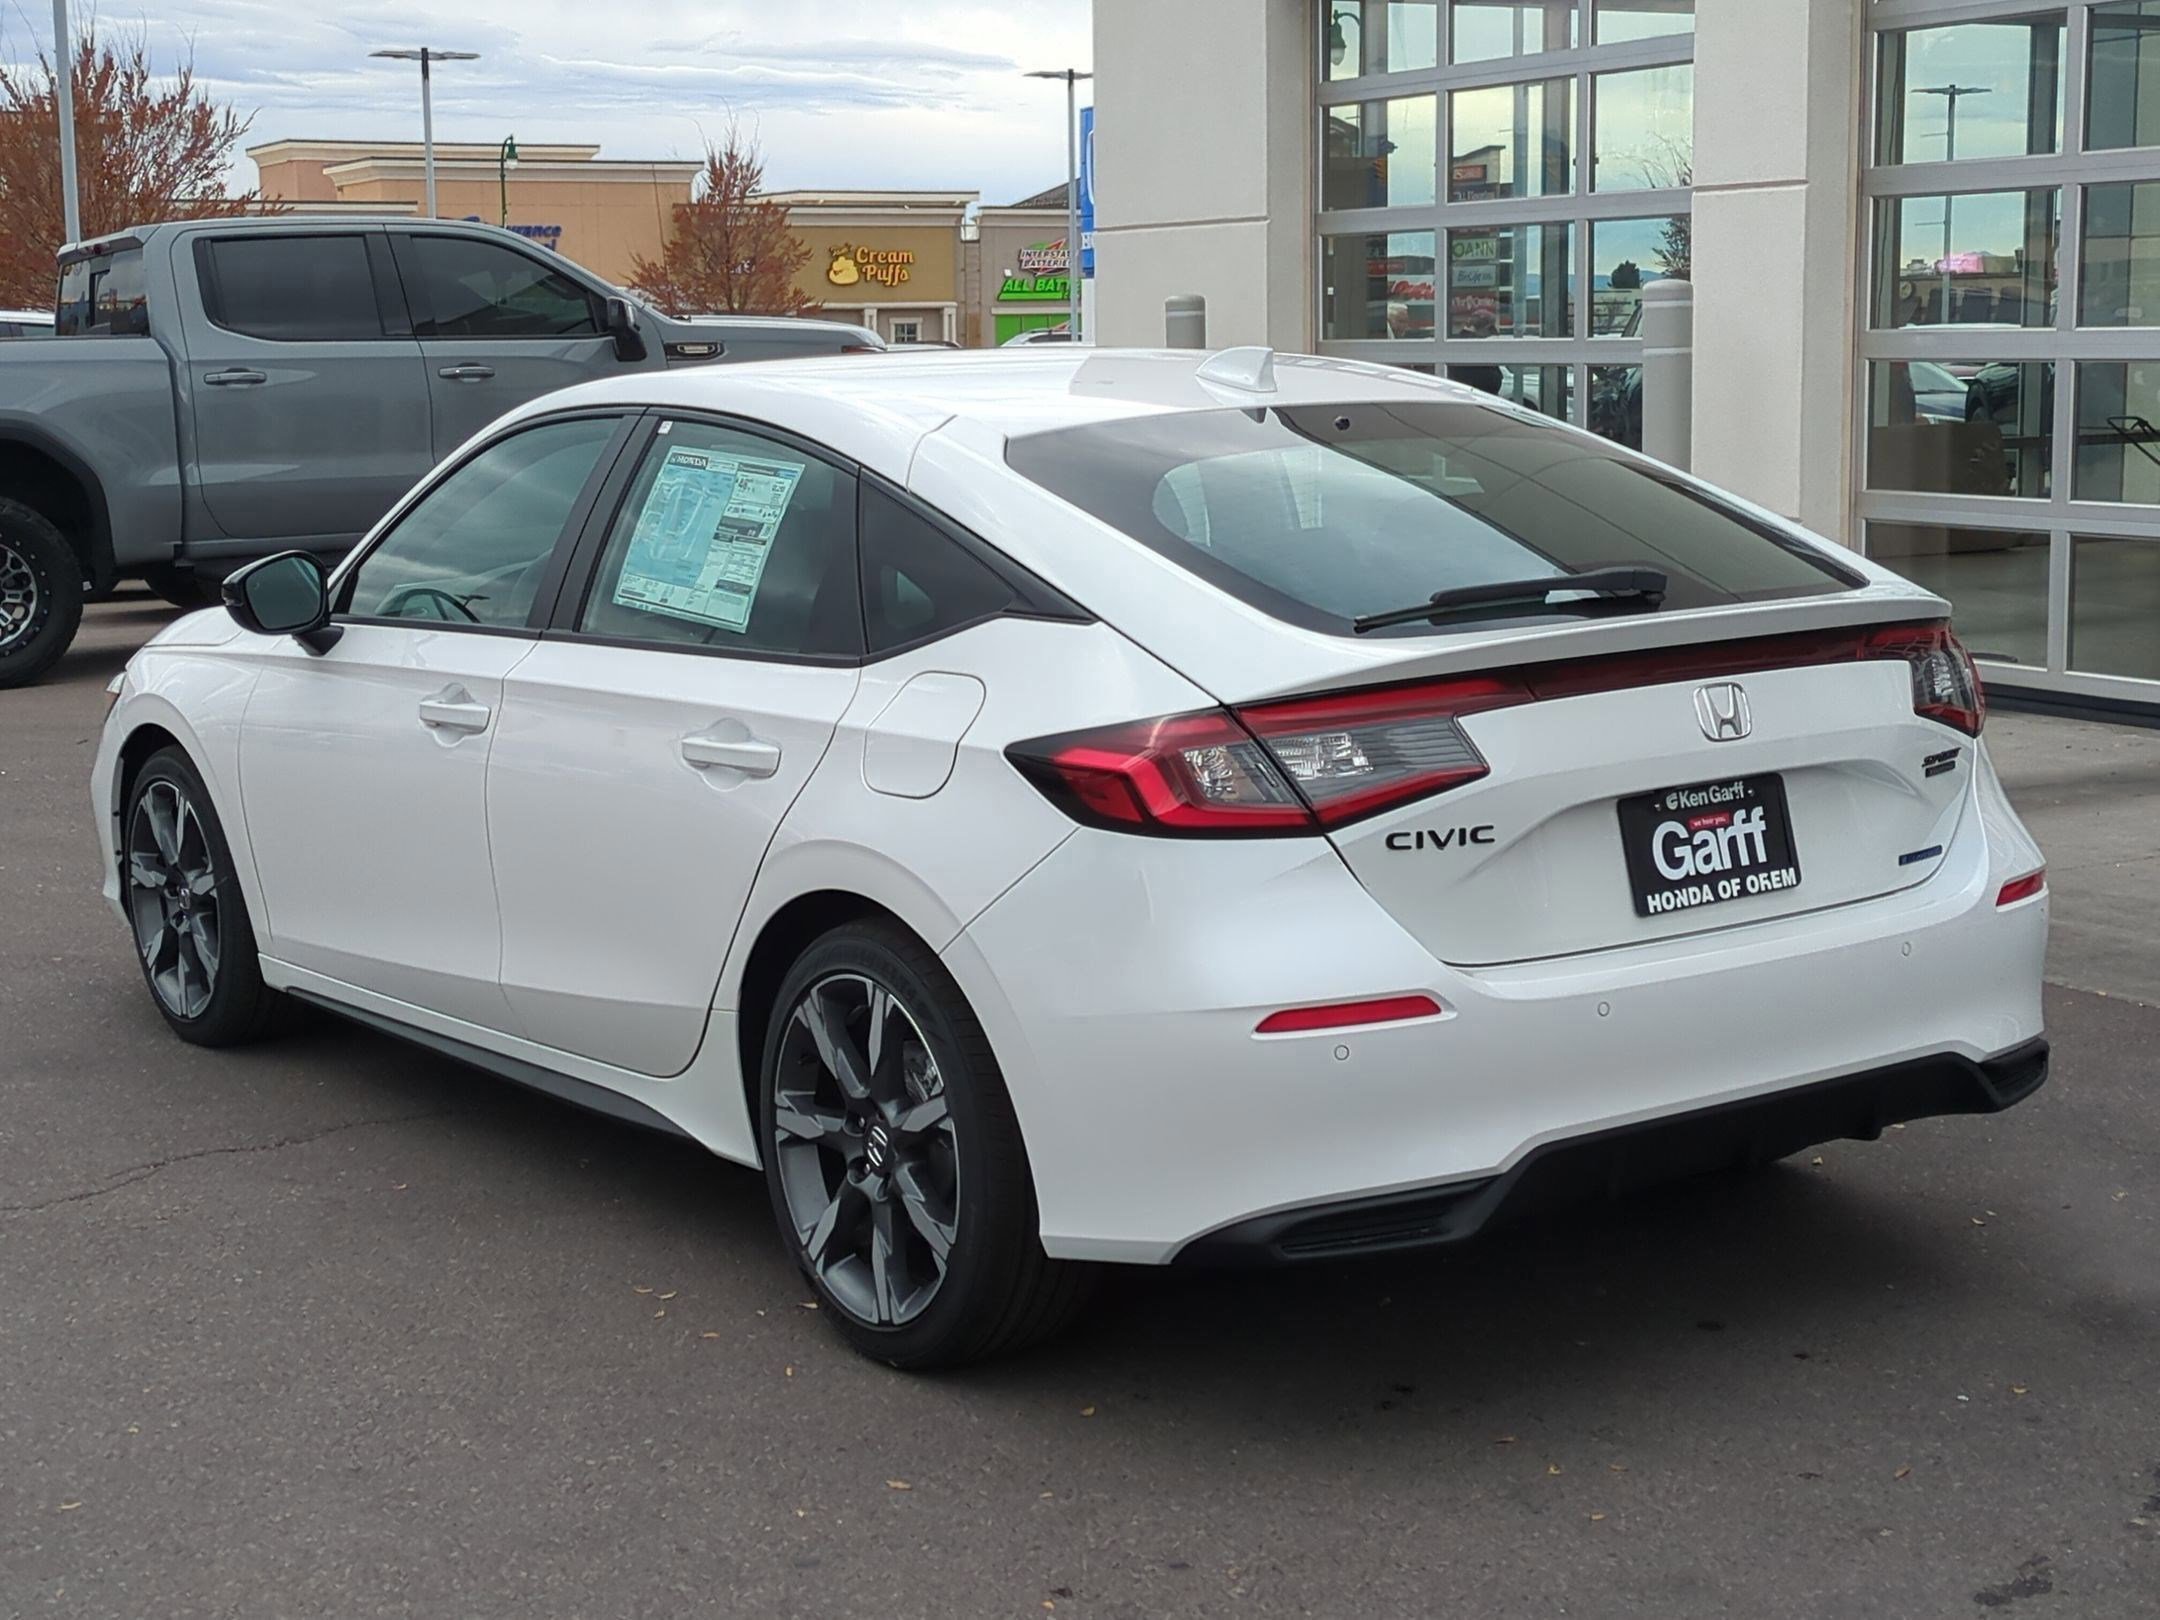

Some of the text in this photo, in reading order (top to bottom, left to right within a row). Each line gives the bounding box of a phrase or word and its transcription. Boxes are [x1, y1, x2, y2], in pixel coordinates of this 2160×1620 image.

[856, 246, 914, 264] Cream
[862, 264, 909, 286] Puffs
[1002, 278, 1030, 292] ALL
[1679, 781, 1744, 809] Ken Garff
[1385, 825, 1496, 851] CIVIC
[1652, 806, 1768, 881] Garff
[1647, 867, 1797, 914] HONDA OF OREM
